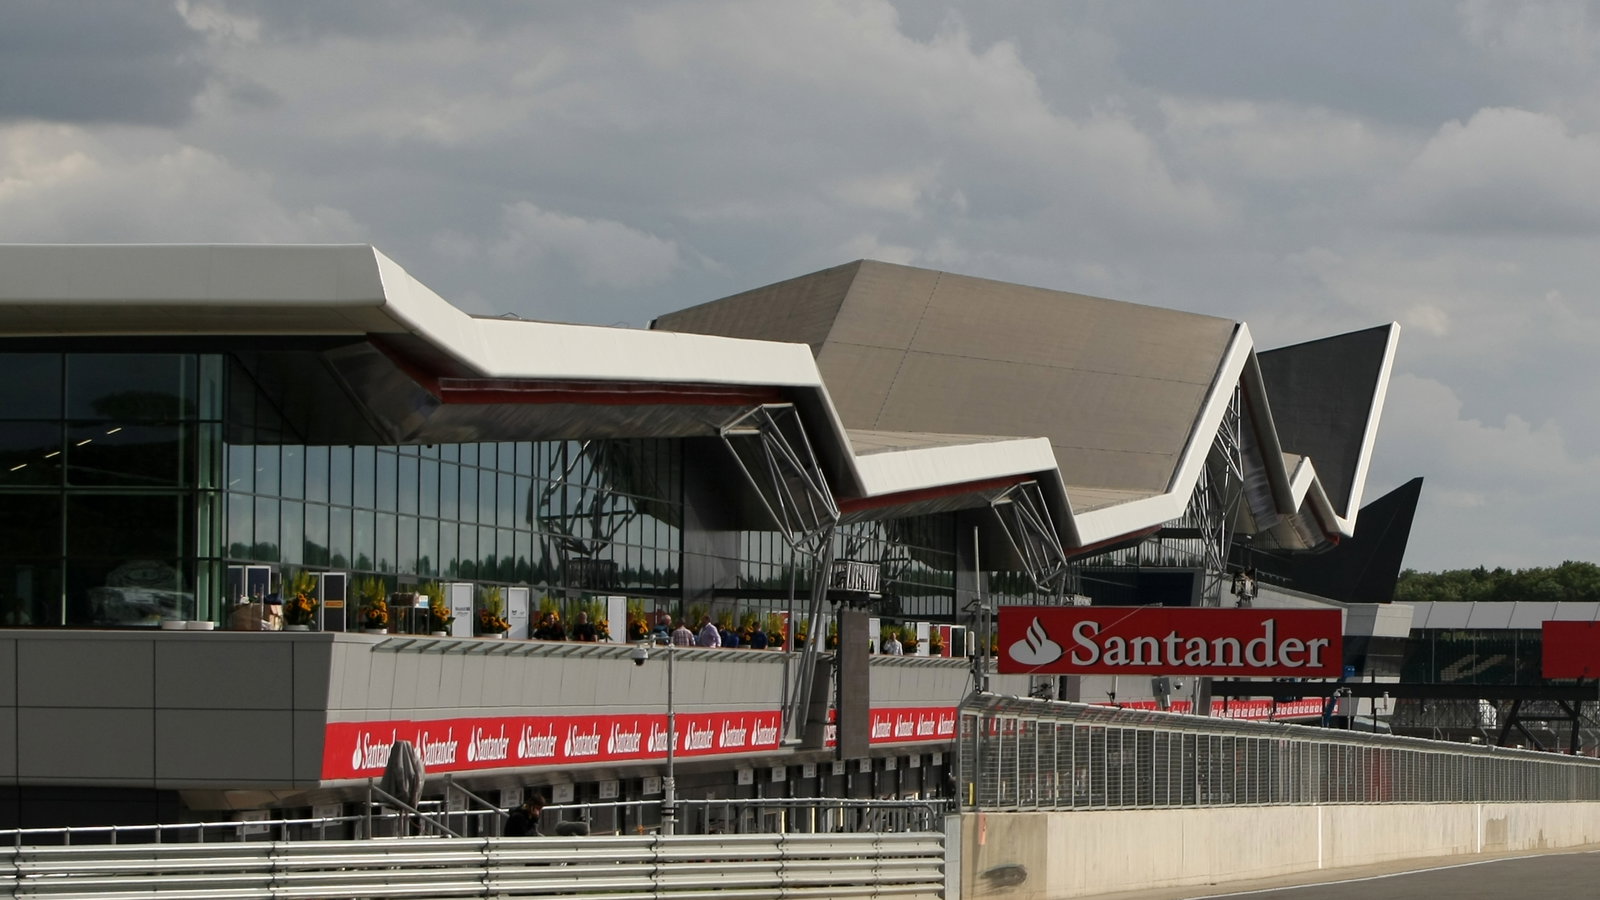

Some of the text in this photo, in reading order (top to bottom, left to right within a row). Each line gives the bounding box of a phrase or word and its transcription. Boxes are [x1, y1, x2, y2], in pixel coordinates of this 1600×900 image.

[1071, 618, 1329, 668] Santander
[422, 725, 459, 766] Santander
[475, 723, 510, 762] Santander
[524, 721, 558, 759] Santander
[570, 721, 601, 757] Santander
[613, 720, 643, 754] Santander
